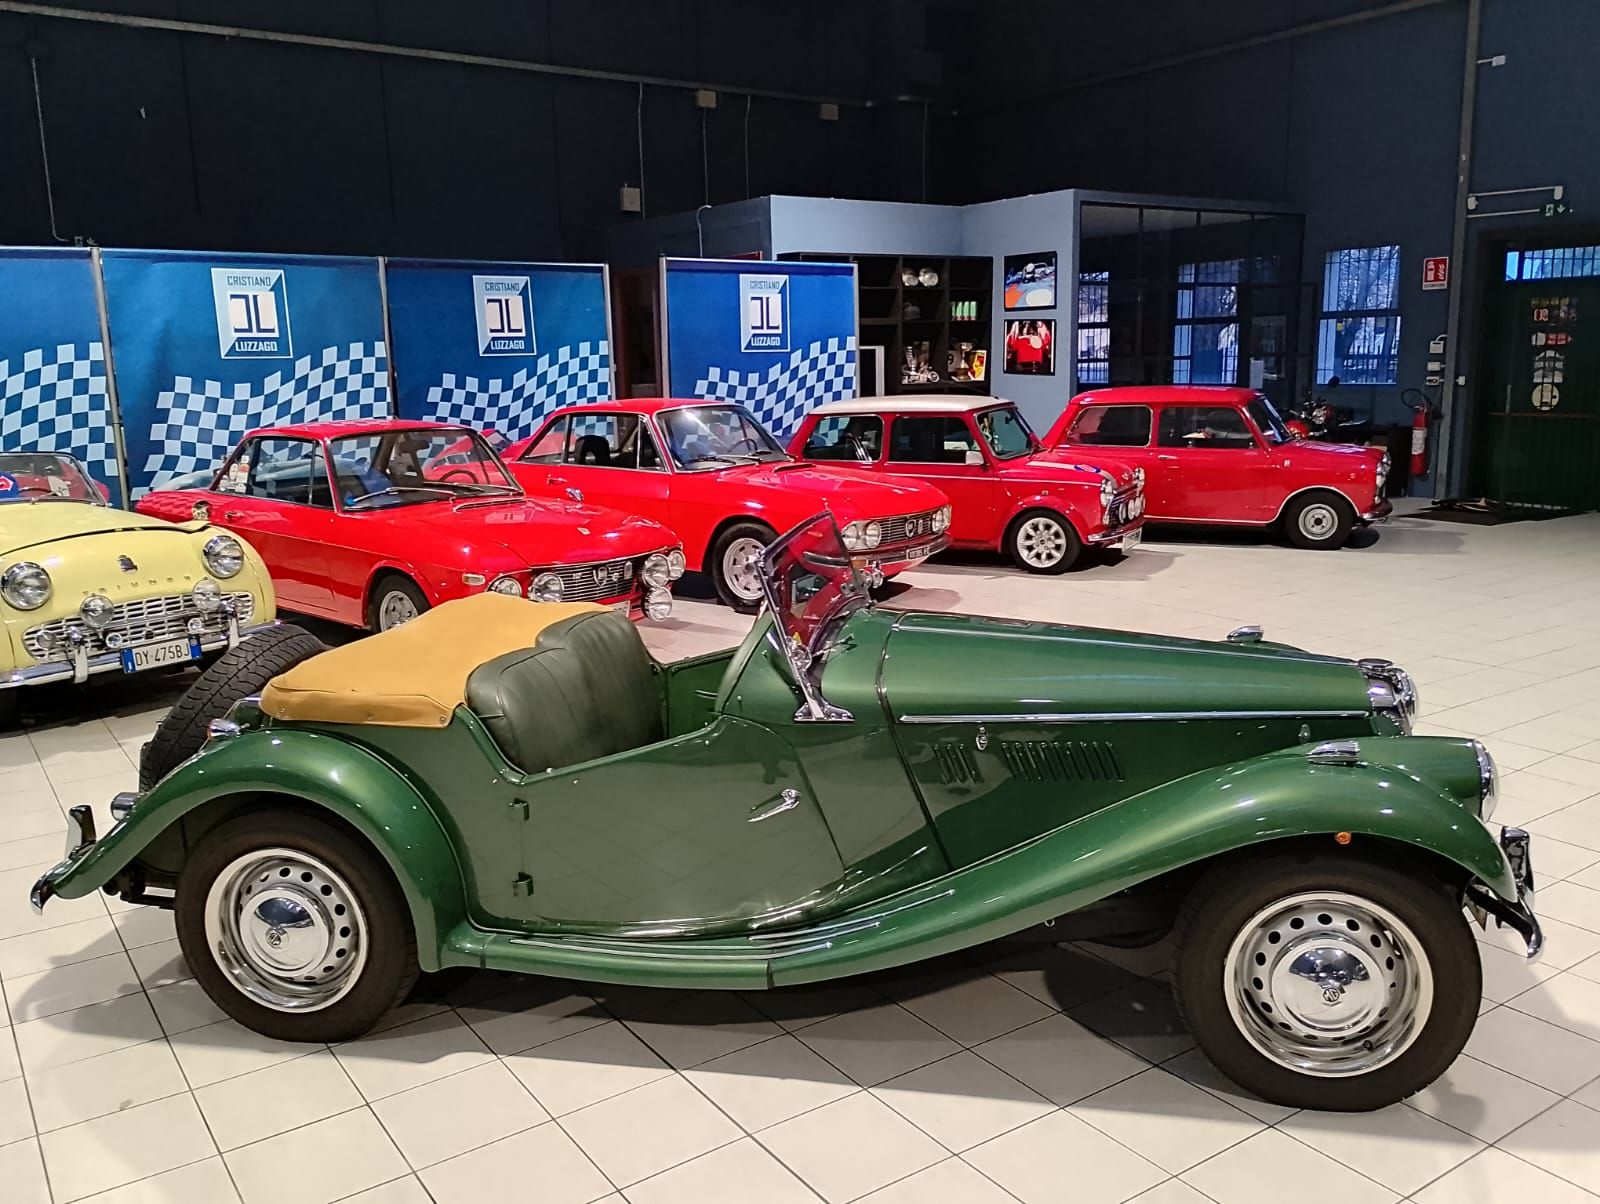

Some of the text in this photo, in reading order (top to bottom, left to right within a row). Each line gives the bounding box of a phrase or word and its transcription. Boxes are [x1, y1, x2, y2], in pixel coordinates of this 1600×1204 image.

[227, 275, 272, 287] CRISTIANO
[484, 281, 520, 292] CRISTIANO
[749, 280, 780, 290] CRISTIANO
[235, 341, 278, 352] LUZZAGO
[490, 340, 525, 350] LUZZAGO
[751, 336, 781, 346] LUZZAGO
[135, 642, 190, 666] DY 475BJ
[1323, 988, 1340, 1002] MG
